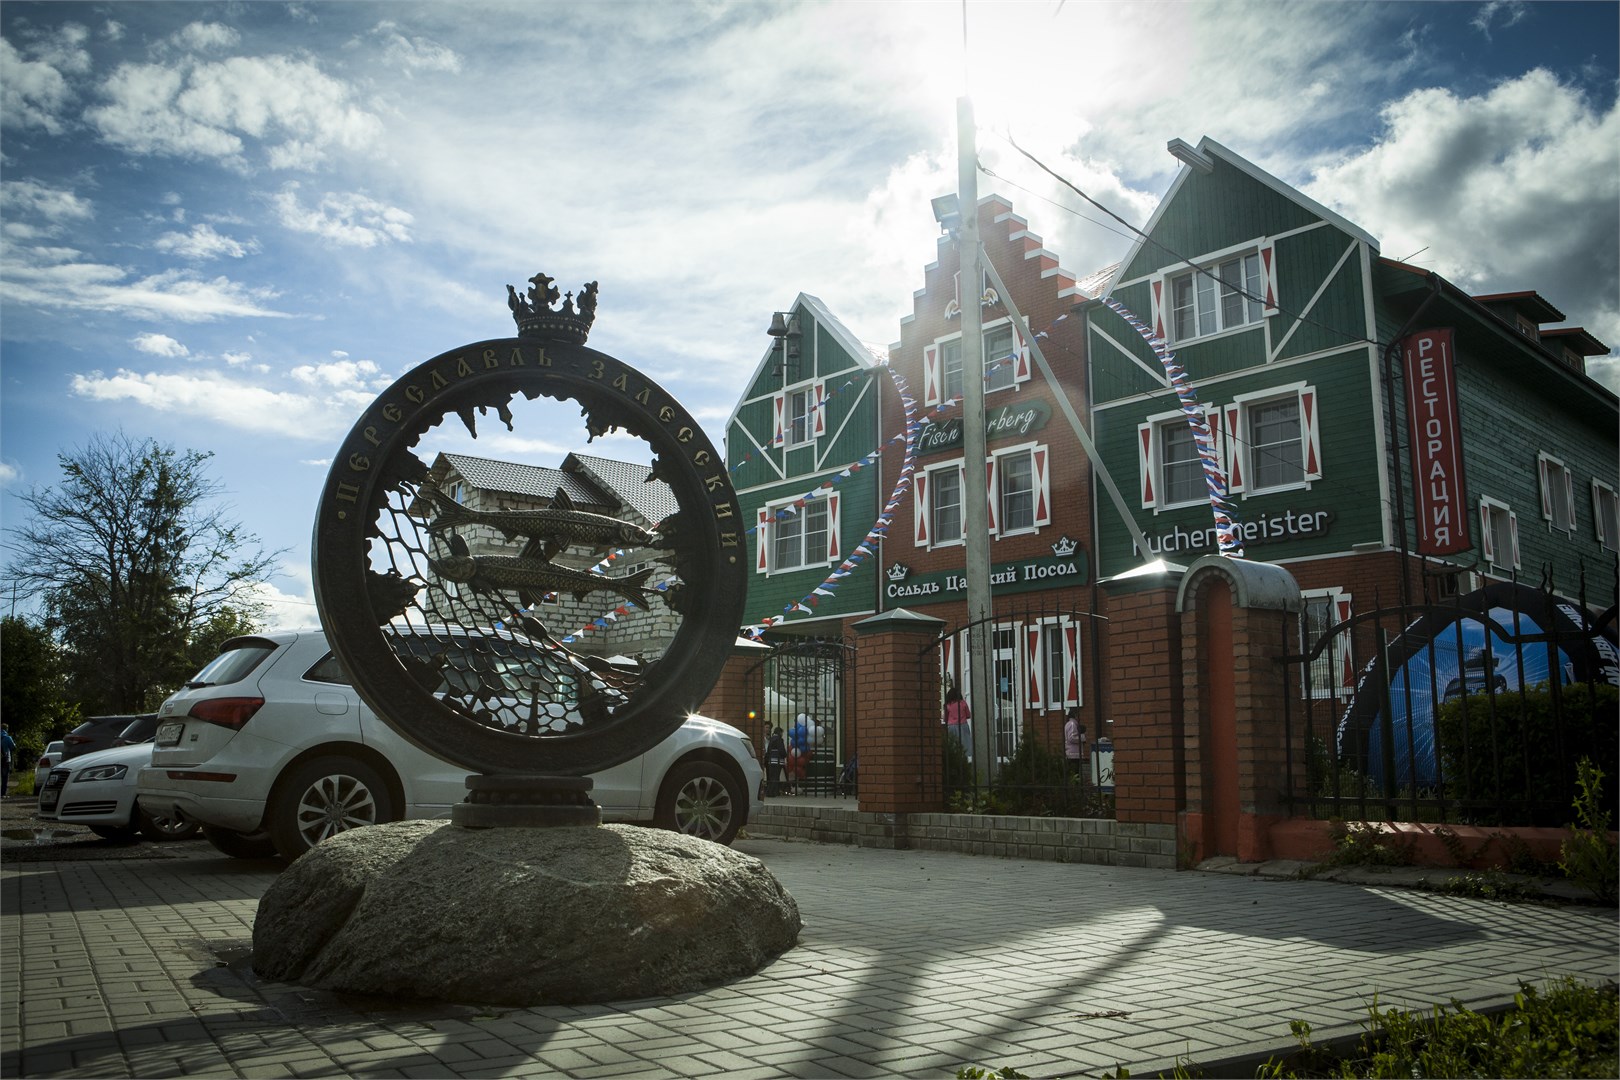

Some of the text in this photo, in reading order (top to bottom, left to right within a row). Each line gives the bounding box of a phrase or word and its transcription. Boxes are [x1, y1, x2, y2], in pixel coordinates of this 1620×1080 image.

[1418, 337, 1450, 548] РЕСТОРАЦИЯ
[887, 562, 1078, 598] Сельдь Цакий Посол
